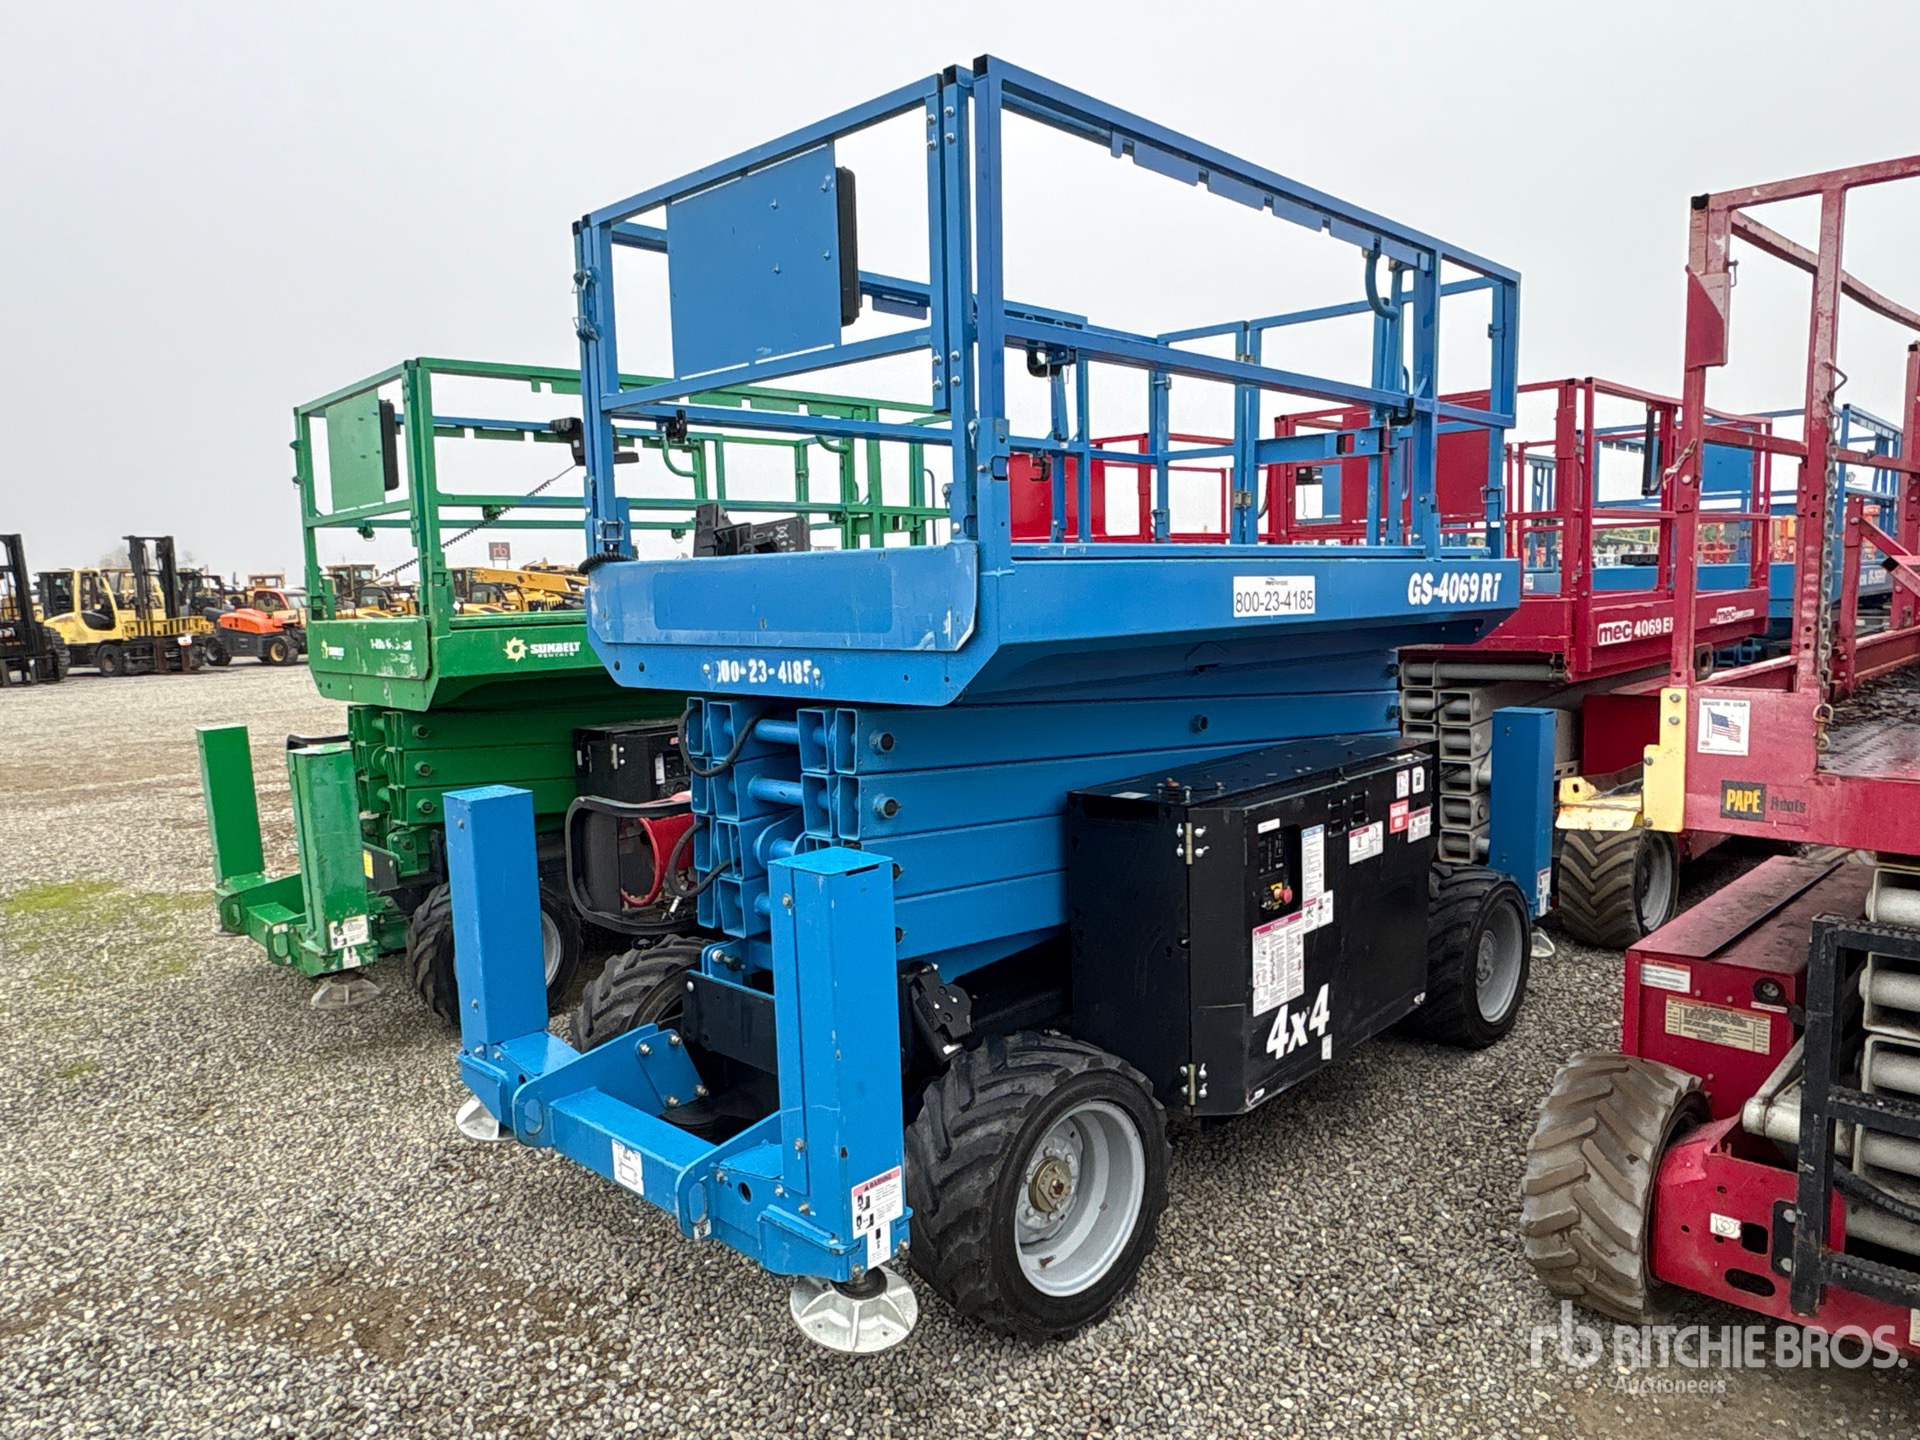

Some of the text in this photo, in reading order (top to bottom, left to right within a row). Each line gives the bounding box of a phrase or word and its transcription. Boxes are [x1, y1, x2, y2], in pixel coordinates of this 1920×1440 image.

[493, 544, 508, 556] rb
[1235, 590, 1314, 613] 800-23-4185
[1600, 621, 1632, 644] mec
[1634, 618, 1662, 637] 4069
[530, 642, 581, 655] SUNBELT
[1266, 982, 1331, 1060] 4x4
